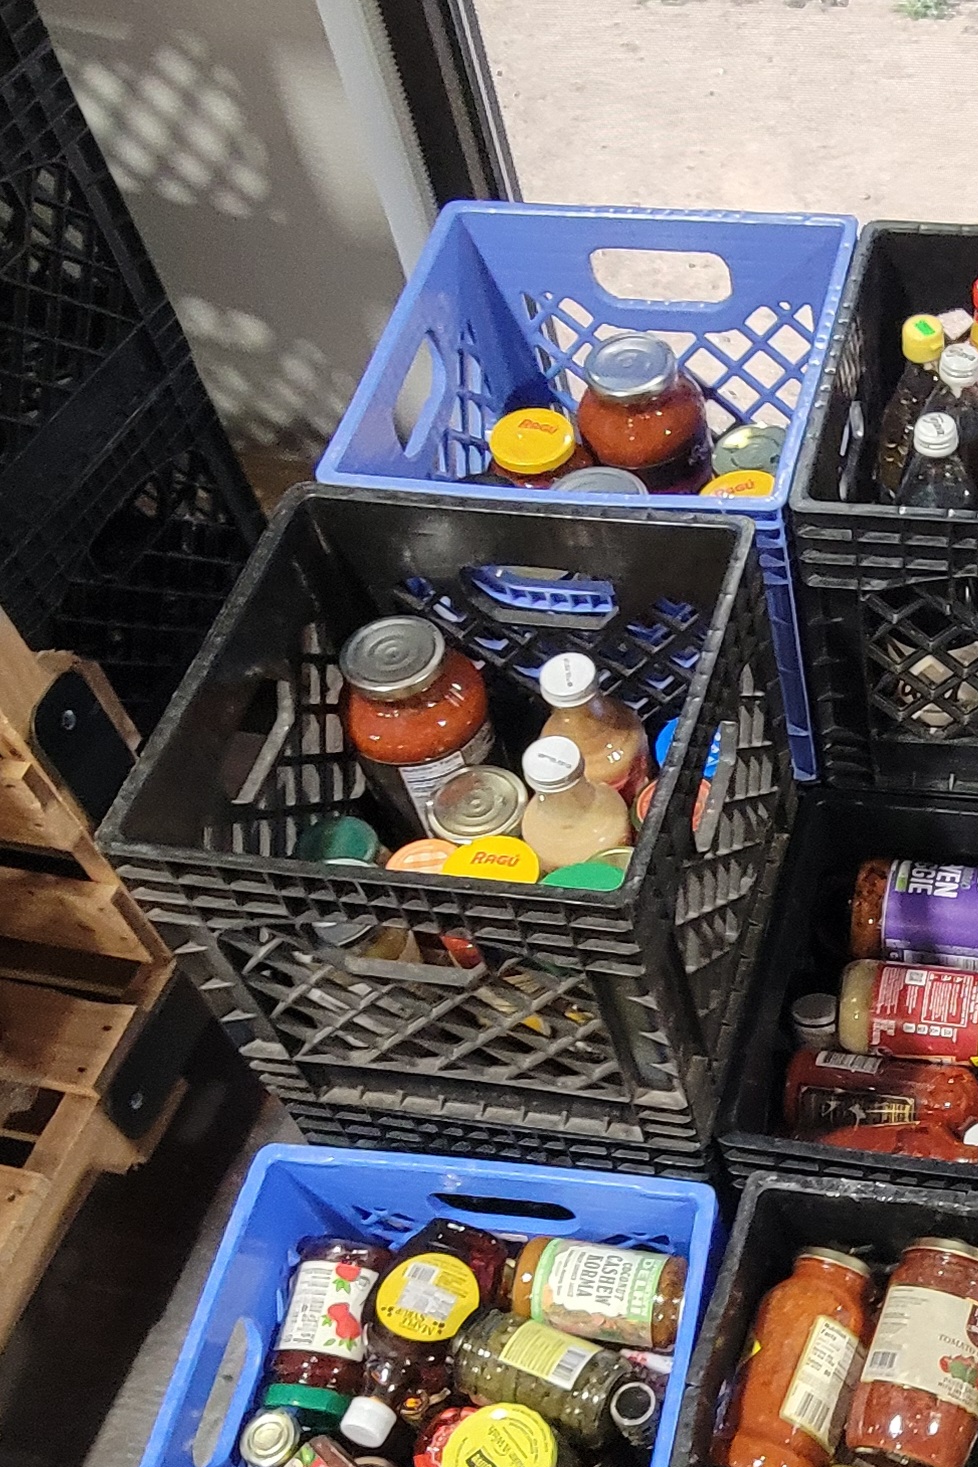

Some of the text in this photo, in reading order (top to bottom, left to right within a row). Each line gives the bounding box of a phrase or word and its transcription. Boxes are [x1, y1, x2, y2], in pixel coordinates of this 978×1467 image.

[470, 850, 521, 868] RAGÚ
[576, 1254, 602, 1297] KORMA
[595, 1255, 622, 1306] CASHEW
[614, 1262, 632, 1301] COCONUT
[630, 1258, 652, 1316] DELHI
[400, 1318, 436, 1334] MAPLE
[820, 1328, 837, 1341] Facts
[938, 1333, 977, 1355] TOMATO
